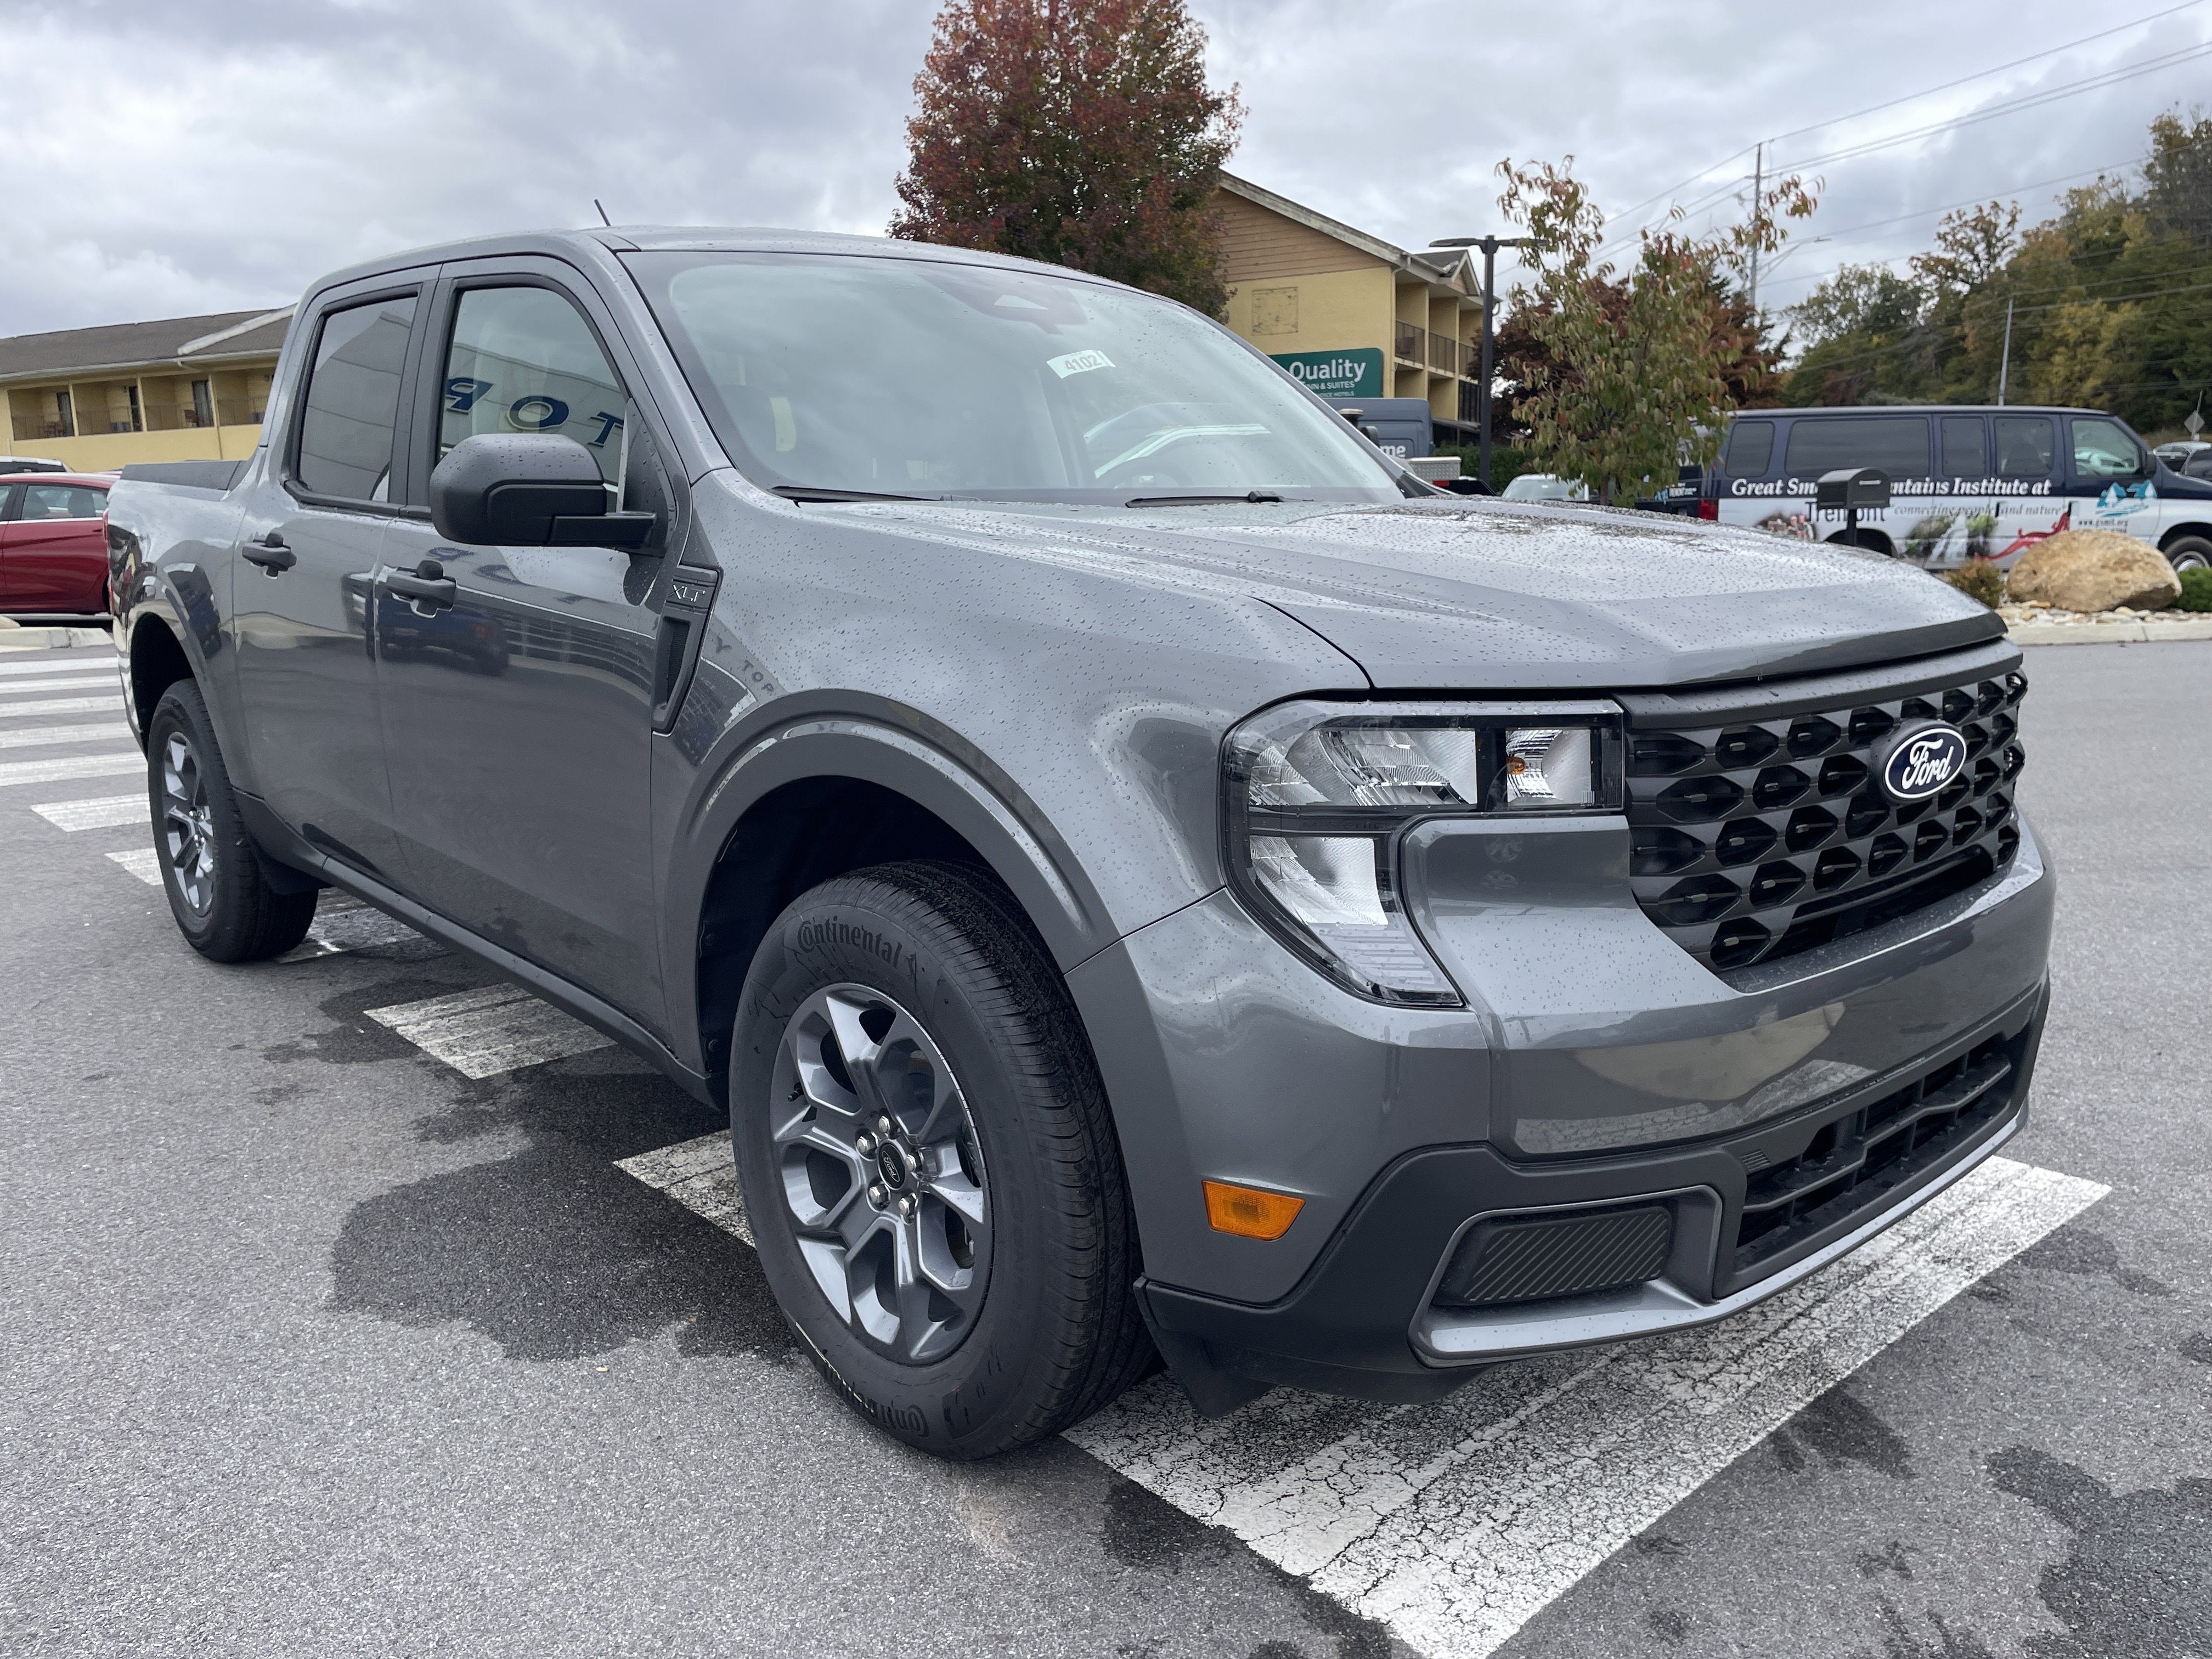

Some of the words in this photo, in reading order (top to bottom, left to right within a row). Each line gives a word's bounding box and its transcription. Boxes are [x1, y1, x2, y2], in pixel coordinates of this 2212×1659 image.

[1064, 354, 1102, 371] 4102
[1289, 358, 1367, 383] Quality
[1327, 380, 1355, 390] SUITES
[1731, 478, 1784, 496] Great
[1952, 477, 2029, 495] Institute
[2032, 478, 2051, 495] at
[2001, 503, 2023, 515] and
[668, 584, 706, 602] XLT
[1901, 738, 1955, 790] Ford
[797, 915, 903, 969] Continental
[883, 1156, 897, 1177] Ford
